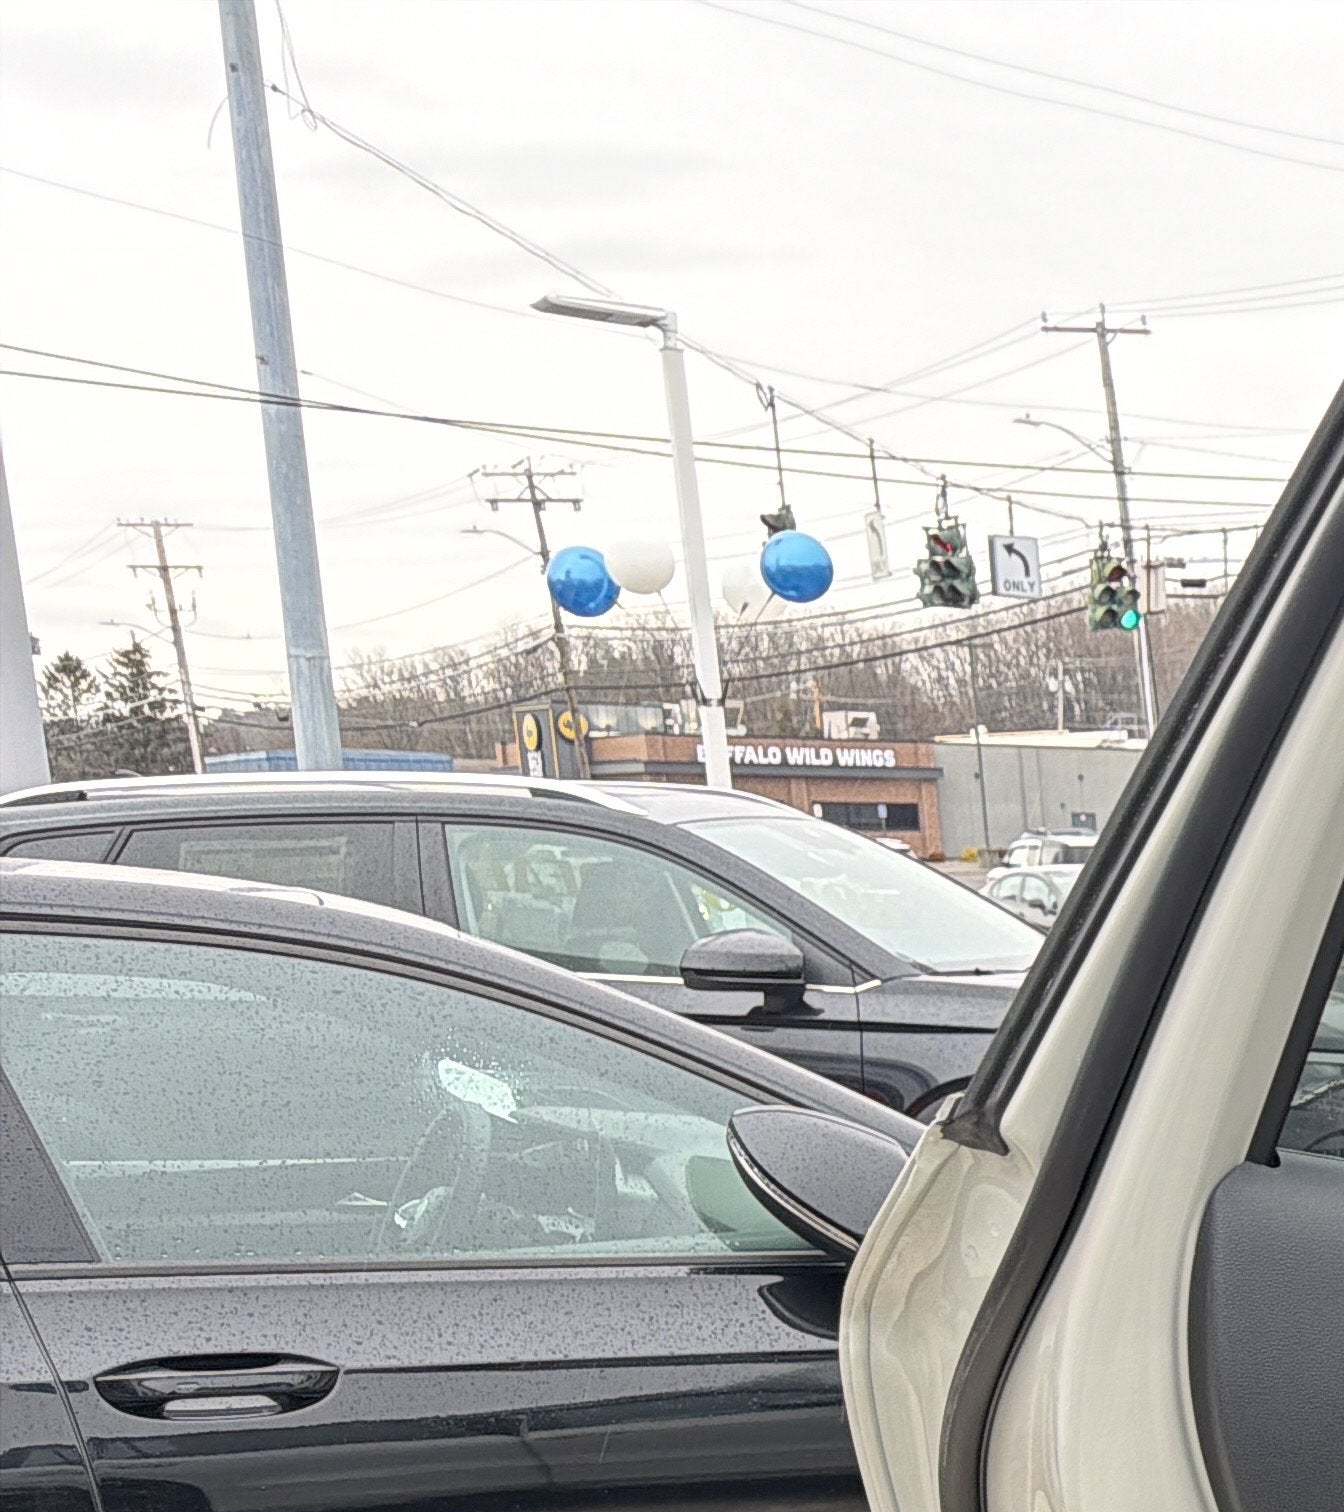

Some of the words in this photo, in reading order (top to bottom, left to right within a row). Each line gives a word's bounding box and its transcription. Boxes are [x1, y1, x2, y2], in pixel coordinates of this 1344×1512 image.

[1003, 578, 1036, 593] ONLY
[696, 743, 782, 765] BFFALO
[784, 746, 834, 767] WILD
[835, 747, 896, 768] WINGS
